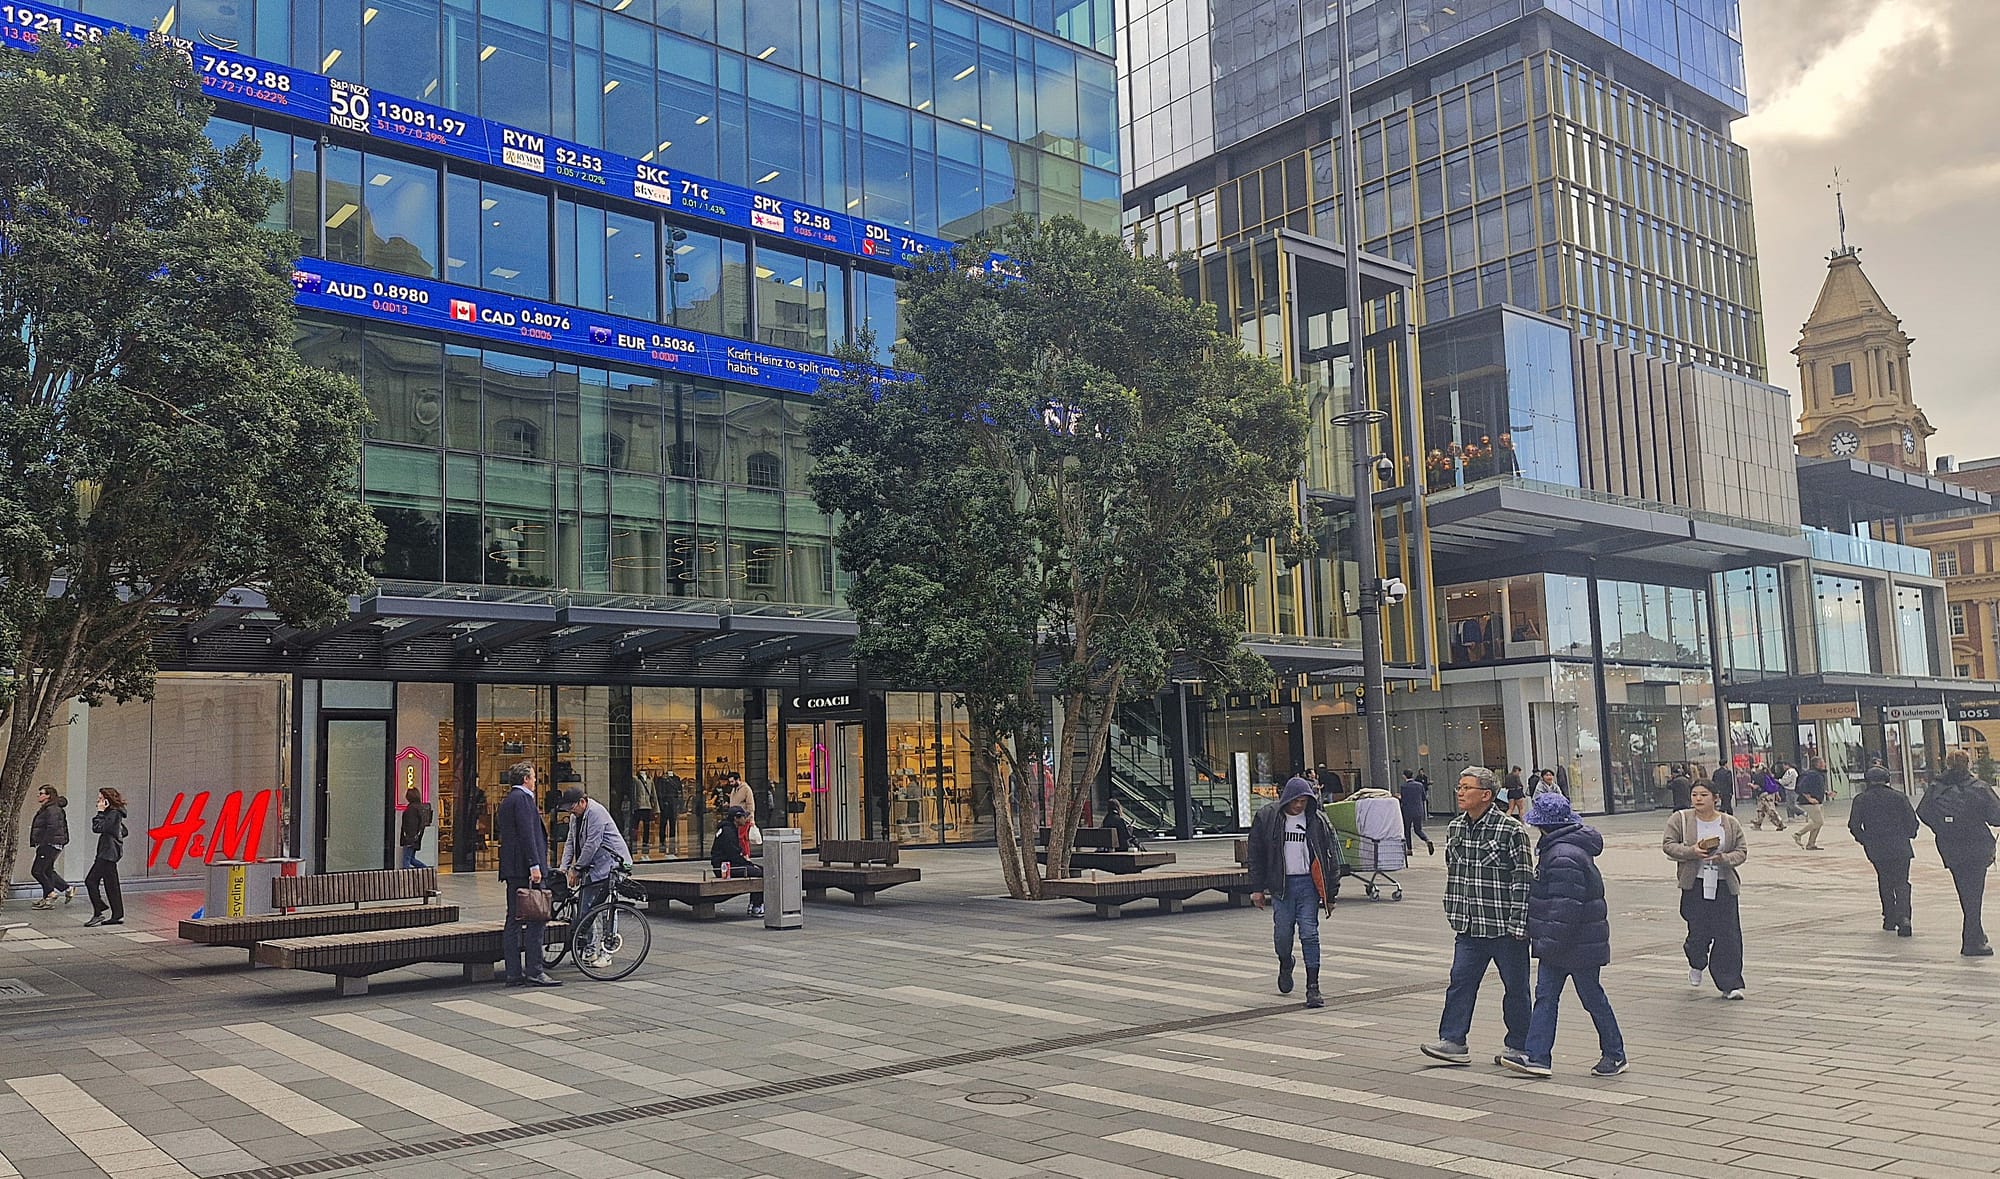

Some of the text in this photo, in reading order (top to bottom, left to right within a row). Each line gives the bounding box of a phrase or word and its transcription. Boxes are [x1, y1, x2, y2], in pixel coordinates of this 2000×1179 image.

[2, 5, 103, 43] 1921.58
[202, 55, 290, 92] 7629.88
[203, 76, 235, 93] 47.72
[246, 86, 288, 105] 0.622%
[330, 89, 370, 121] 50
[330, 113, 371, 134] INDEX
[377, 101, 466, 136] 13081.97
[377, 119, 406, 134] 51.19
[415, 129, 447, 145] 0.39%
[503, 128, 544, 153] RYM
[556, 147, 602, 172] $2.53
[556, 165, 574, 178] 0.05
[581, 171, 606, 185] 2.02%
[636, 164, 669, 185] SKC
[681, 180, 709, 201] 71¢
[682, 197, 697, 208] 0.01
[704, 203, 726, 216] 1.43%
[754, 195, 782, 214] SPK
[793, 209, 831, 231] $2.58
[865, 224, 891, 242] SDL
[901, 237, 924, 254] 71¢
[326, 281, 367, 299] AUD
[373, 282, 429, 304] 0.8980
[481, 308, 516, 326] CAD
[521, 310, 570, 330] 0.8076
[618, 333, 646, 351] EUR
[652, 334, 695, 353] 0.5036
[727, 346, 752, 361] Kraft
[754, 351, 783, 367] Heinz
[785, 358, 796, 369] to
[798, 361, 819, 375] split
[821, 364, 840, 377] into
[727, 359, 759, 376] habits
[808, 696, 849, 708] COACH
[1902, 708, 1940, 717] lululemon
[1959, 708, 1990, 719] BOSS
[1447, 752, 1469, 762] COS
[146, 789, 271, 870] H&M
[1284, 831, 1306, 843] UMA
[230, 877, 244, 918] ecycling
